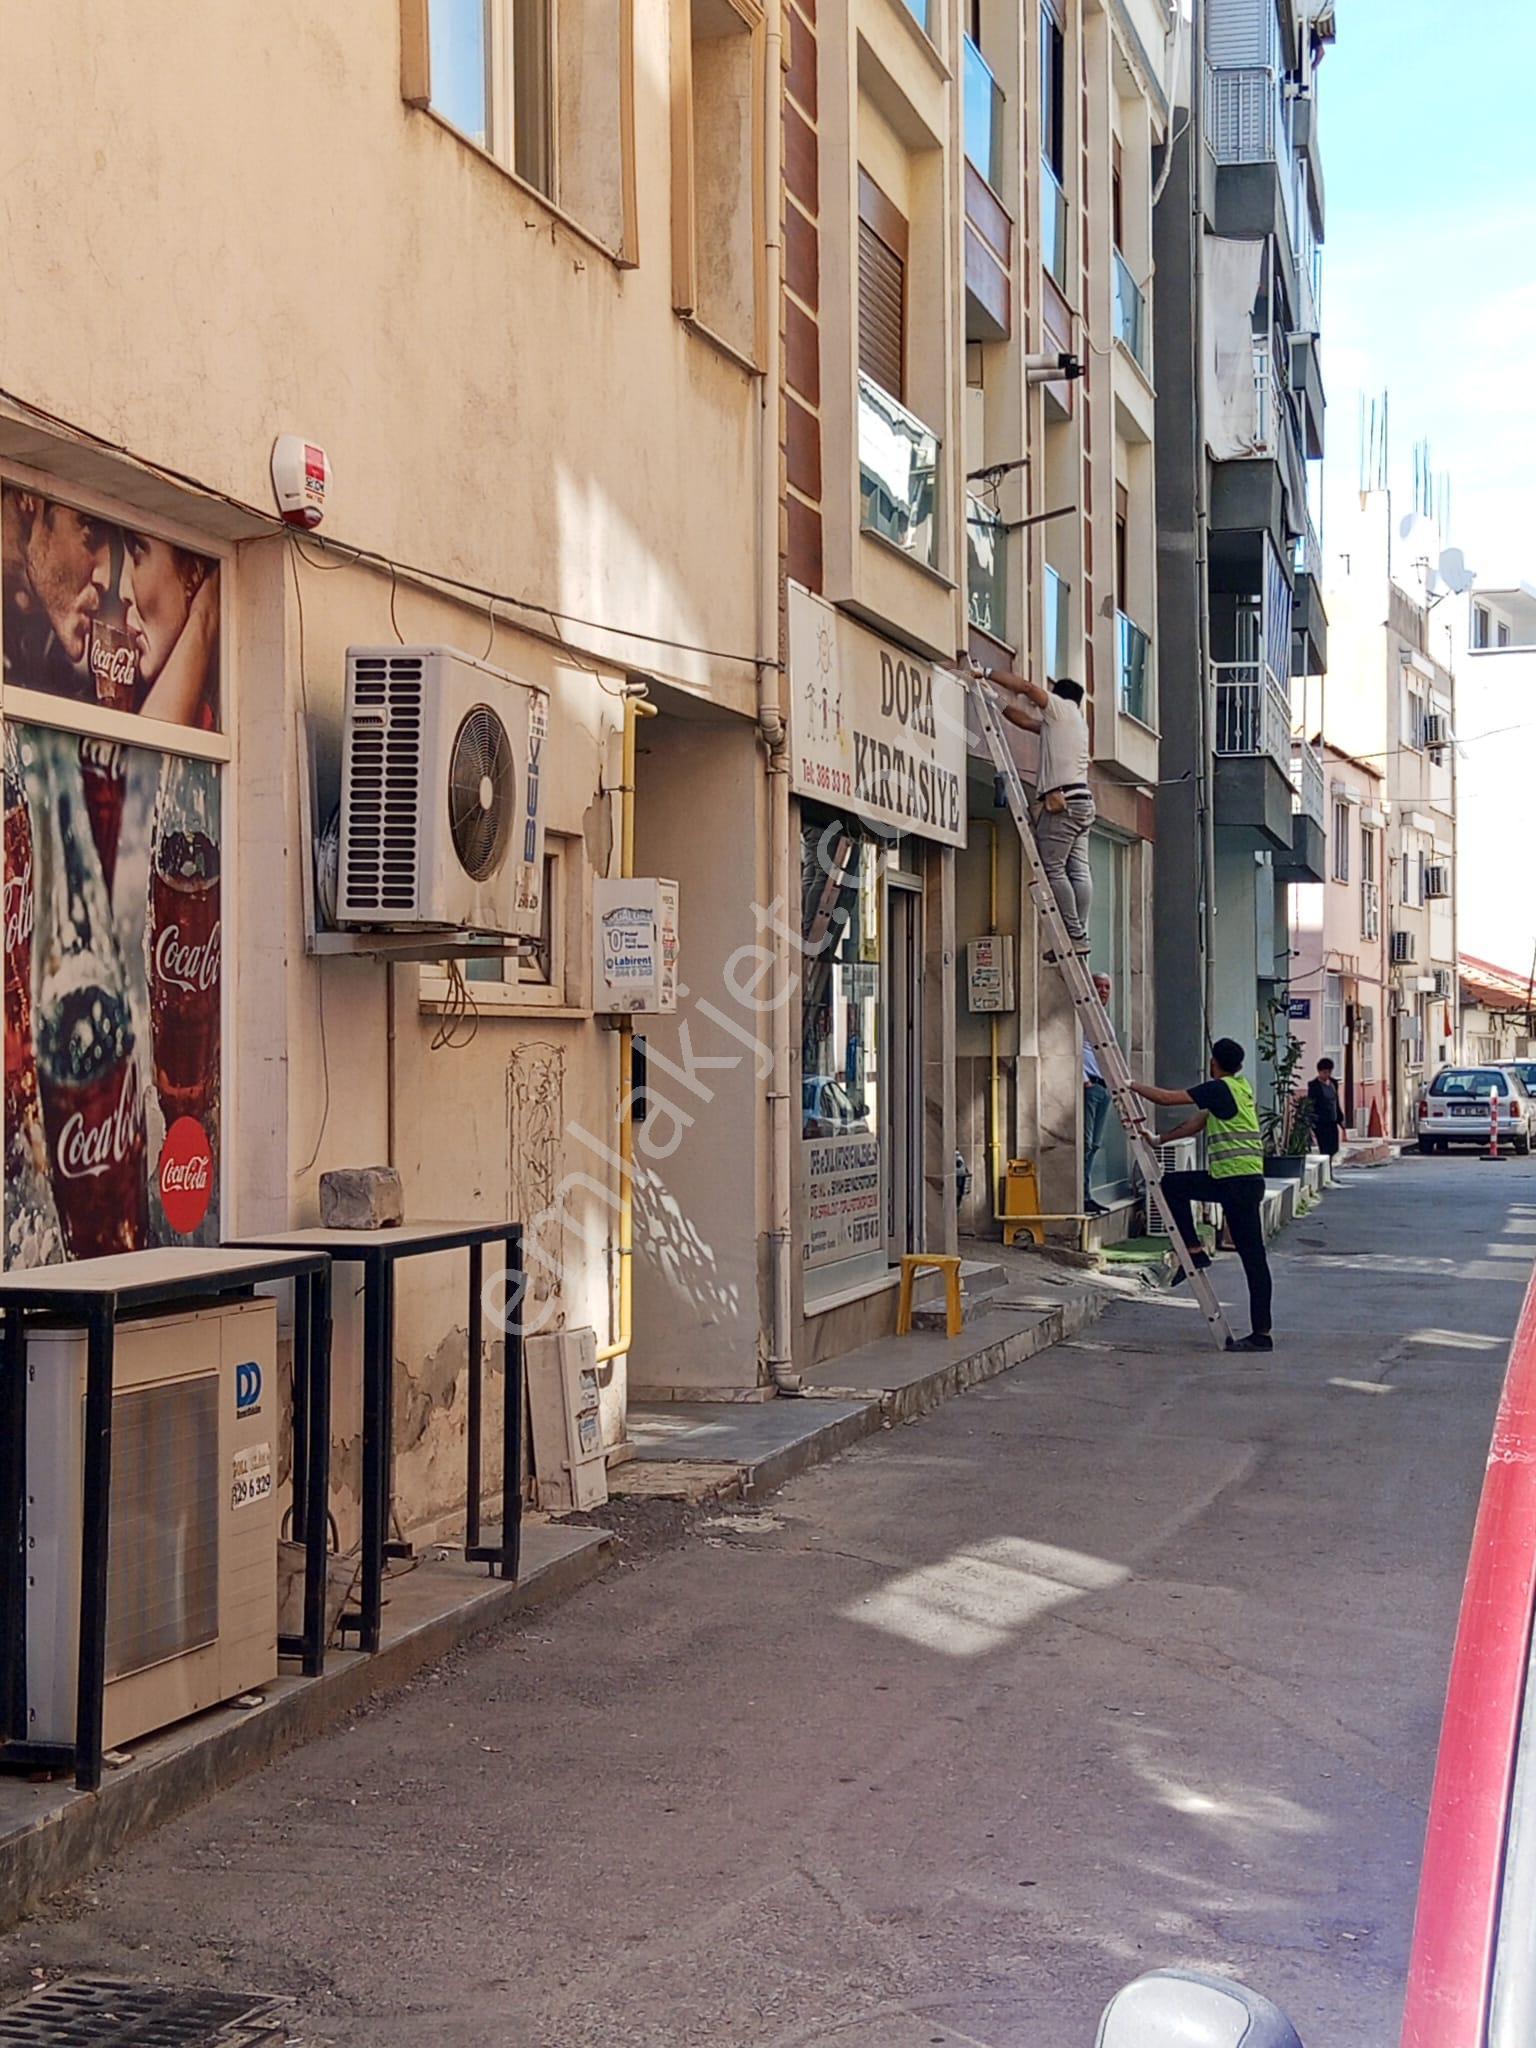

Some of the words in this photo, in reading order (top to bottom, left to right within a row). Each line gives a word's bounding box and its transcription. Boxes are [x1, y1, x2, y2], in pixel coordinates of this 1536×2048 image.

[879, 650, 936, 739] DORA
[853, 731, 960, 833] KIRTASİYE
[156, 921, 220, 991] Coca-Co
[614, 956, 652, 966] Labirent
[162, 1156, 208, 1192] Coca-Cola
[256, 1474, 271, 1496] 329
